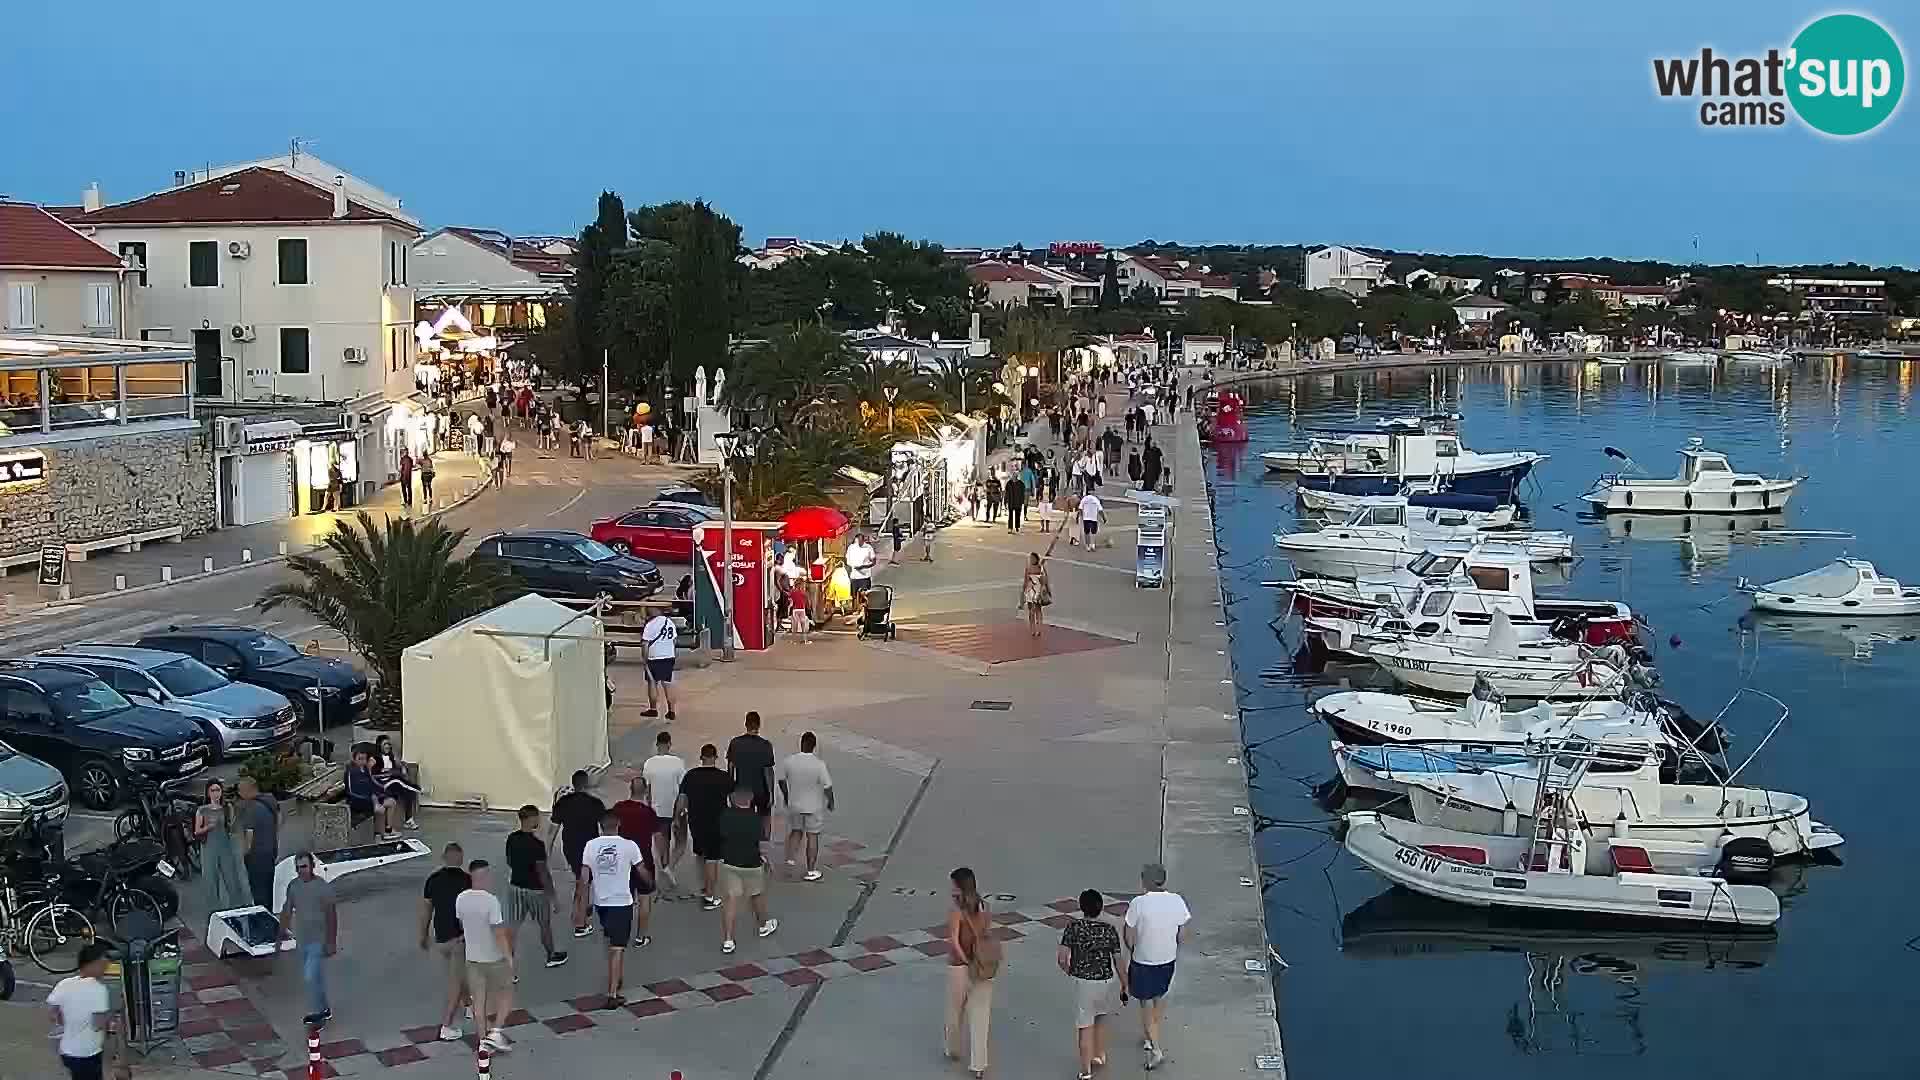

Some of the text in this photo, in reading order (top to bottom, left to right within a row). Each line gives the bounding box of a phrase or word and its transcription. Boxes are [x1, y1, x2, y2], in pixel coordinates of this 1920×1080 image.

[249, 440, 289, 453] MARKET
[1394, 847, 1419, 867] 456
[1420, 852, 1442, 875] NV
